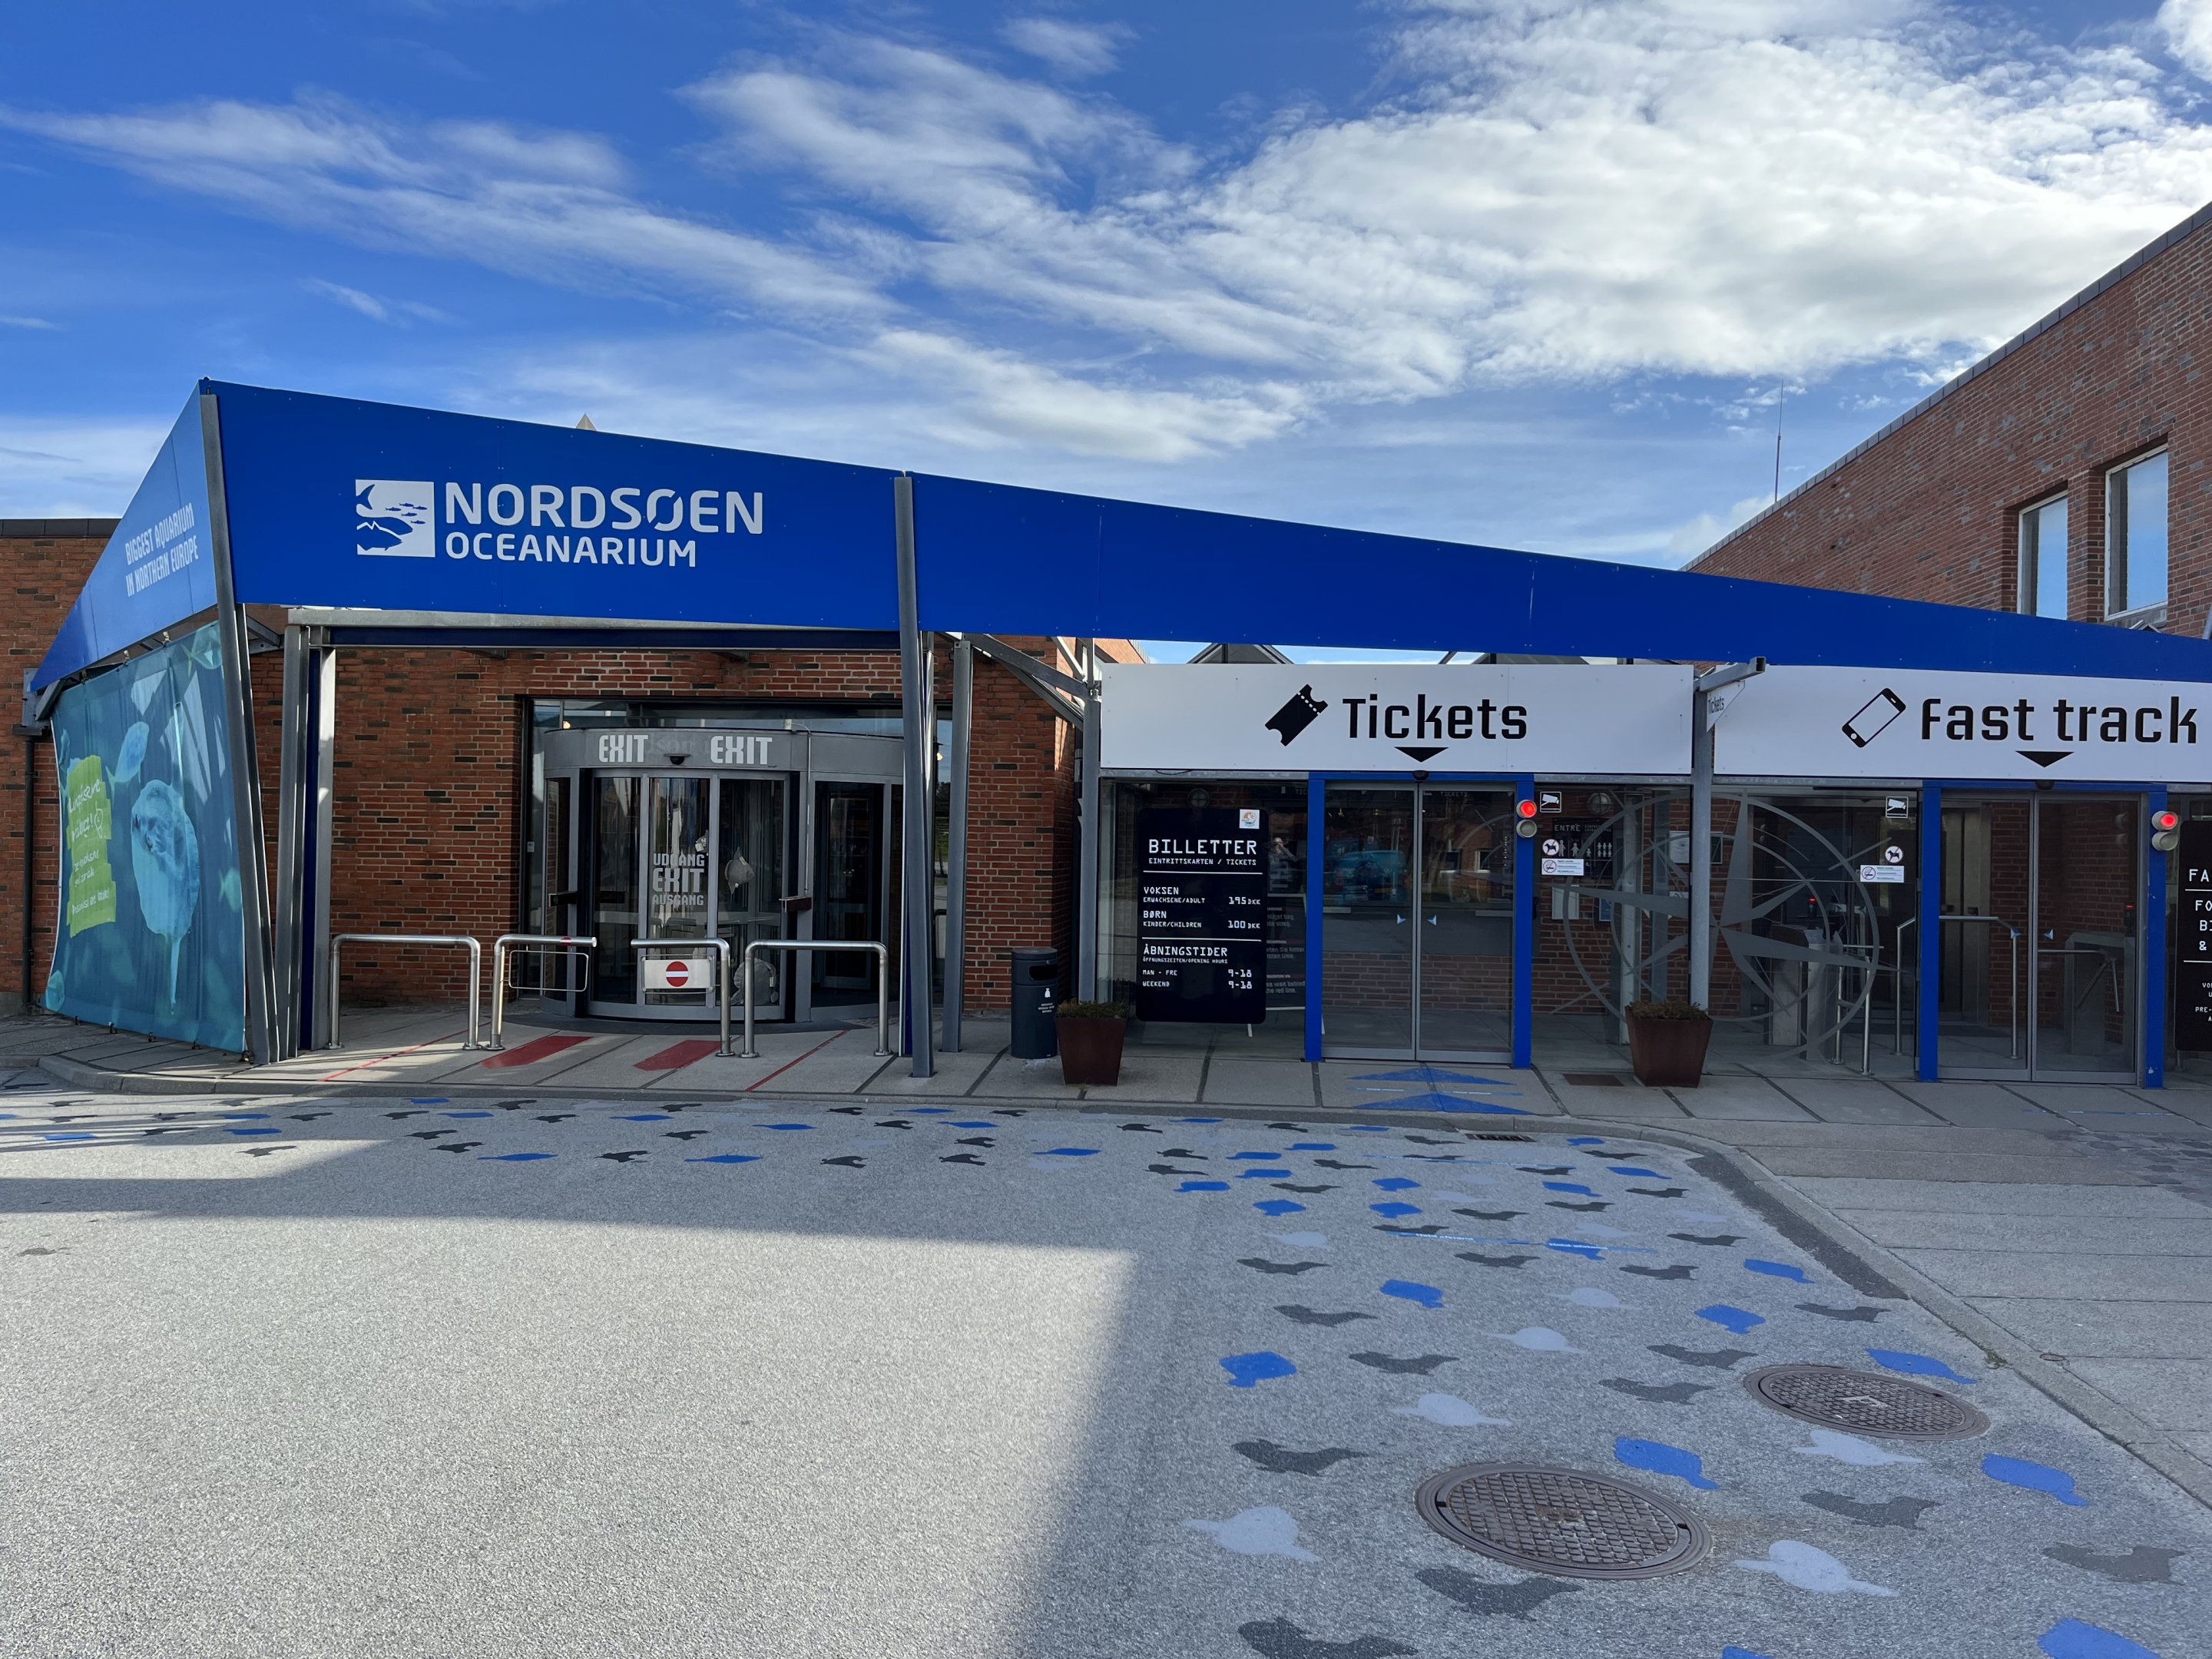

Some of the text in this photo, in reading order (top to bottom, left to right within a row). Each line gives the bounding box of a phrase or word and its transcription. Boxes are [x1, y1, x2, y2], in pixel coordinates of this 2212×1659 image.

[445, 482, 763, 534] NORDSØEN
[125, 502, 195, 565] BIGGEST AQUARIUM
[445, 531, 696, 567] OCEANARIUM
[125, 535, 199, 597] IN NORTHERN EUROPE
[1343, 694, 1527, 739] Tickets
[1922, 696, 2197, 743] Fast track
[599, 735, 648, 763] EXIT
[710, 736, 773, 765] EXIT
[1149, 839, 1257, 855] BILLETTER
[653, 867, 704, 892] EXIT
[1144, 886, 1179, 895] VOKSEN
[652, 894, 704, 906] AUSGANG
[1229, 896, 1247, 905] 195
[1143, 910, 1167, 919] BØRN
[1228, 920, 1246, 929] 100
[1144, 943, 1228, 956] ÅBNINGSTIDER
[2199, 940, 2207, 951] &
[1228, 969, 1252, 978] 9-18
[1228, 981, 1253, 989] 9-18
